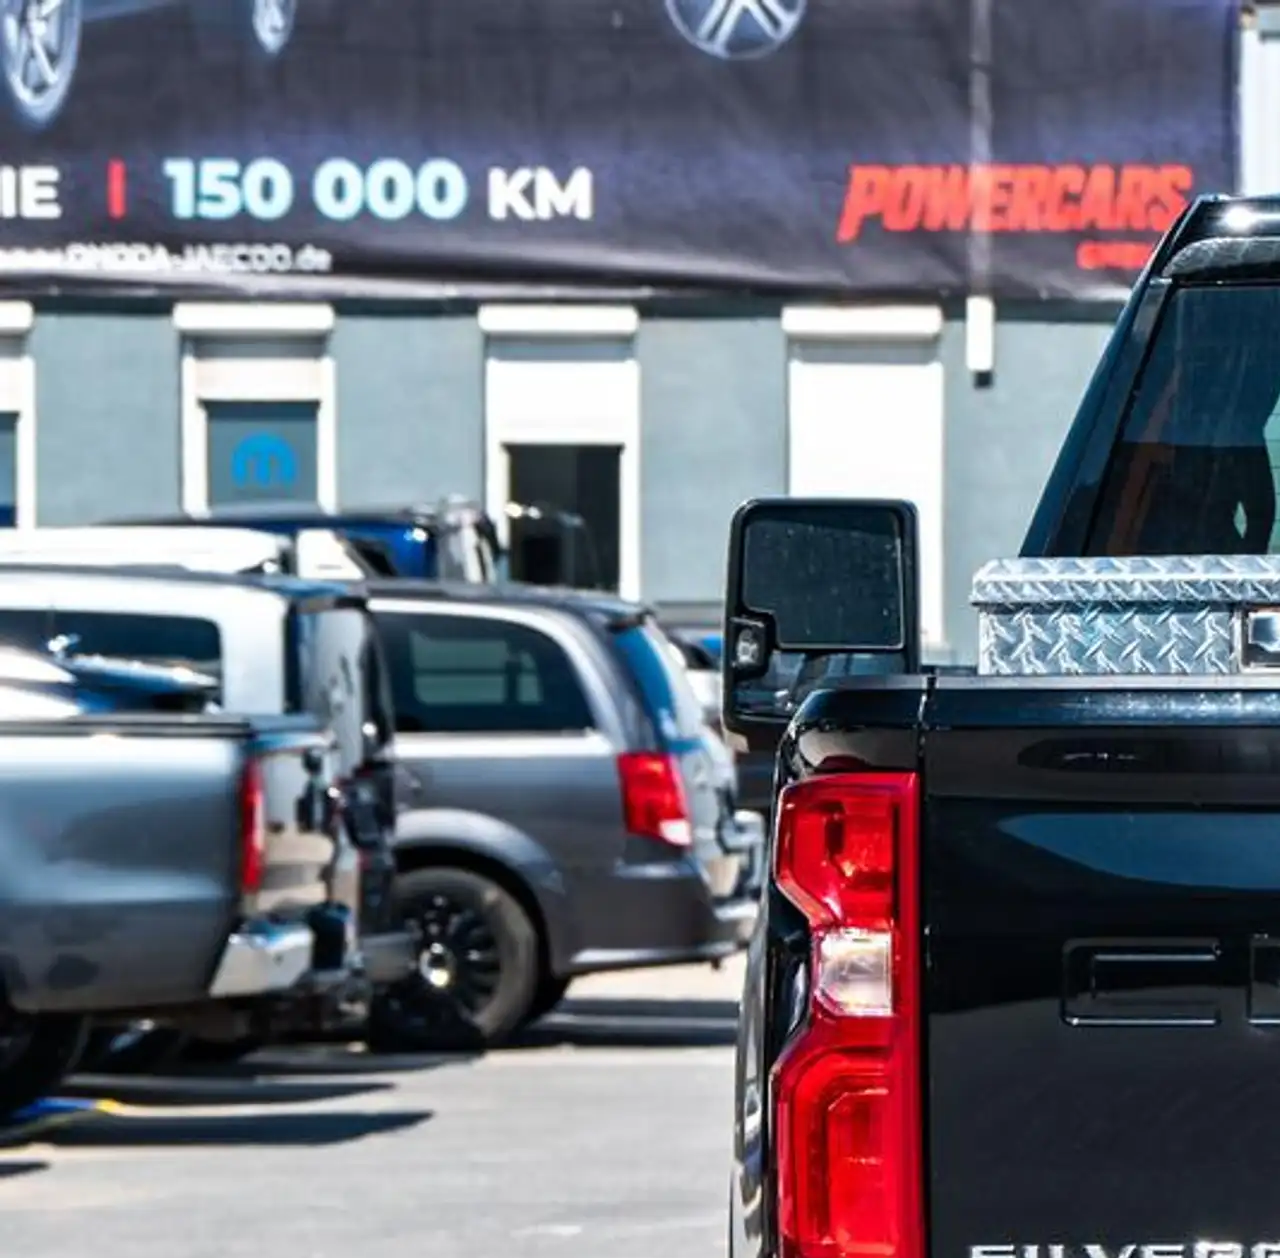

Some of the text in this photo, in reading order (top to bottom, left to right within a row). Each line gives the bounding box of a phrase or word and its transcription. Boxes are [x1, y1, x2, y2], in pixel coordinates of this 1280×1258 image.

[163, 158, 293, 219] 150
[313, 158, 467, 220] 000
[488, 167, 594, 220] KM
[836, 164, 1194, 242] POWERCARS
